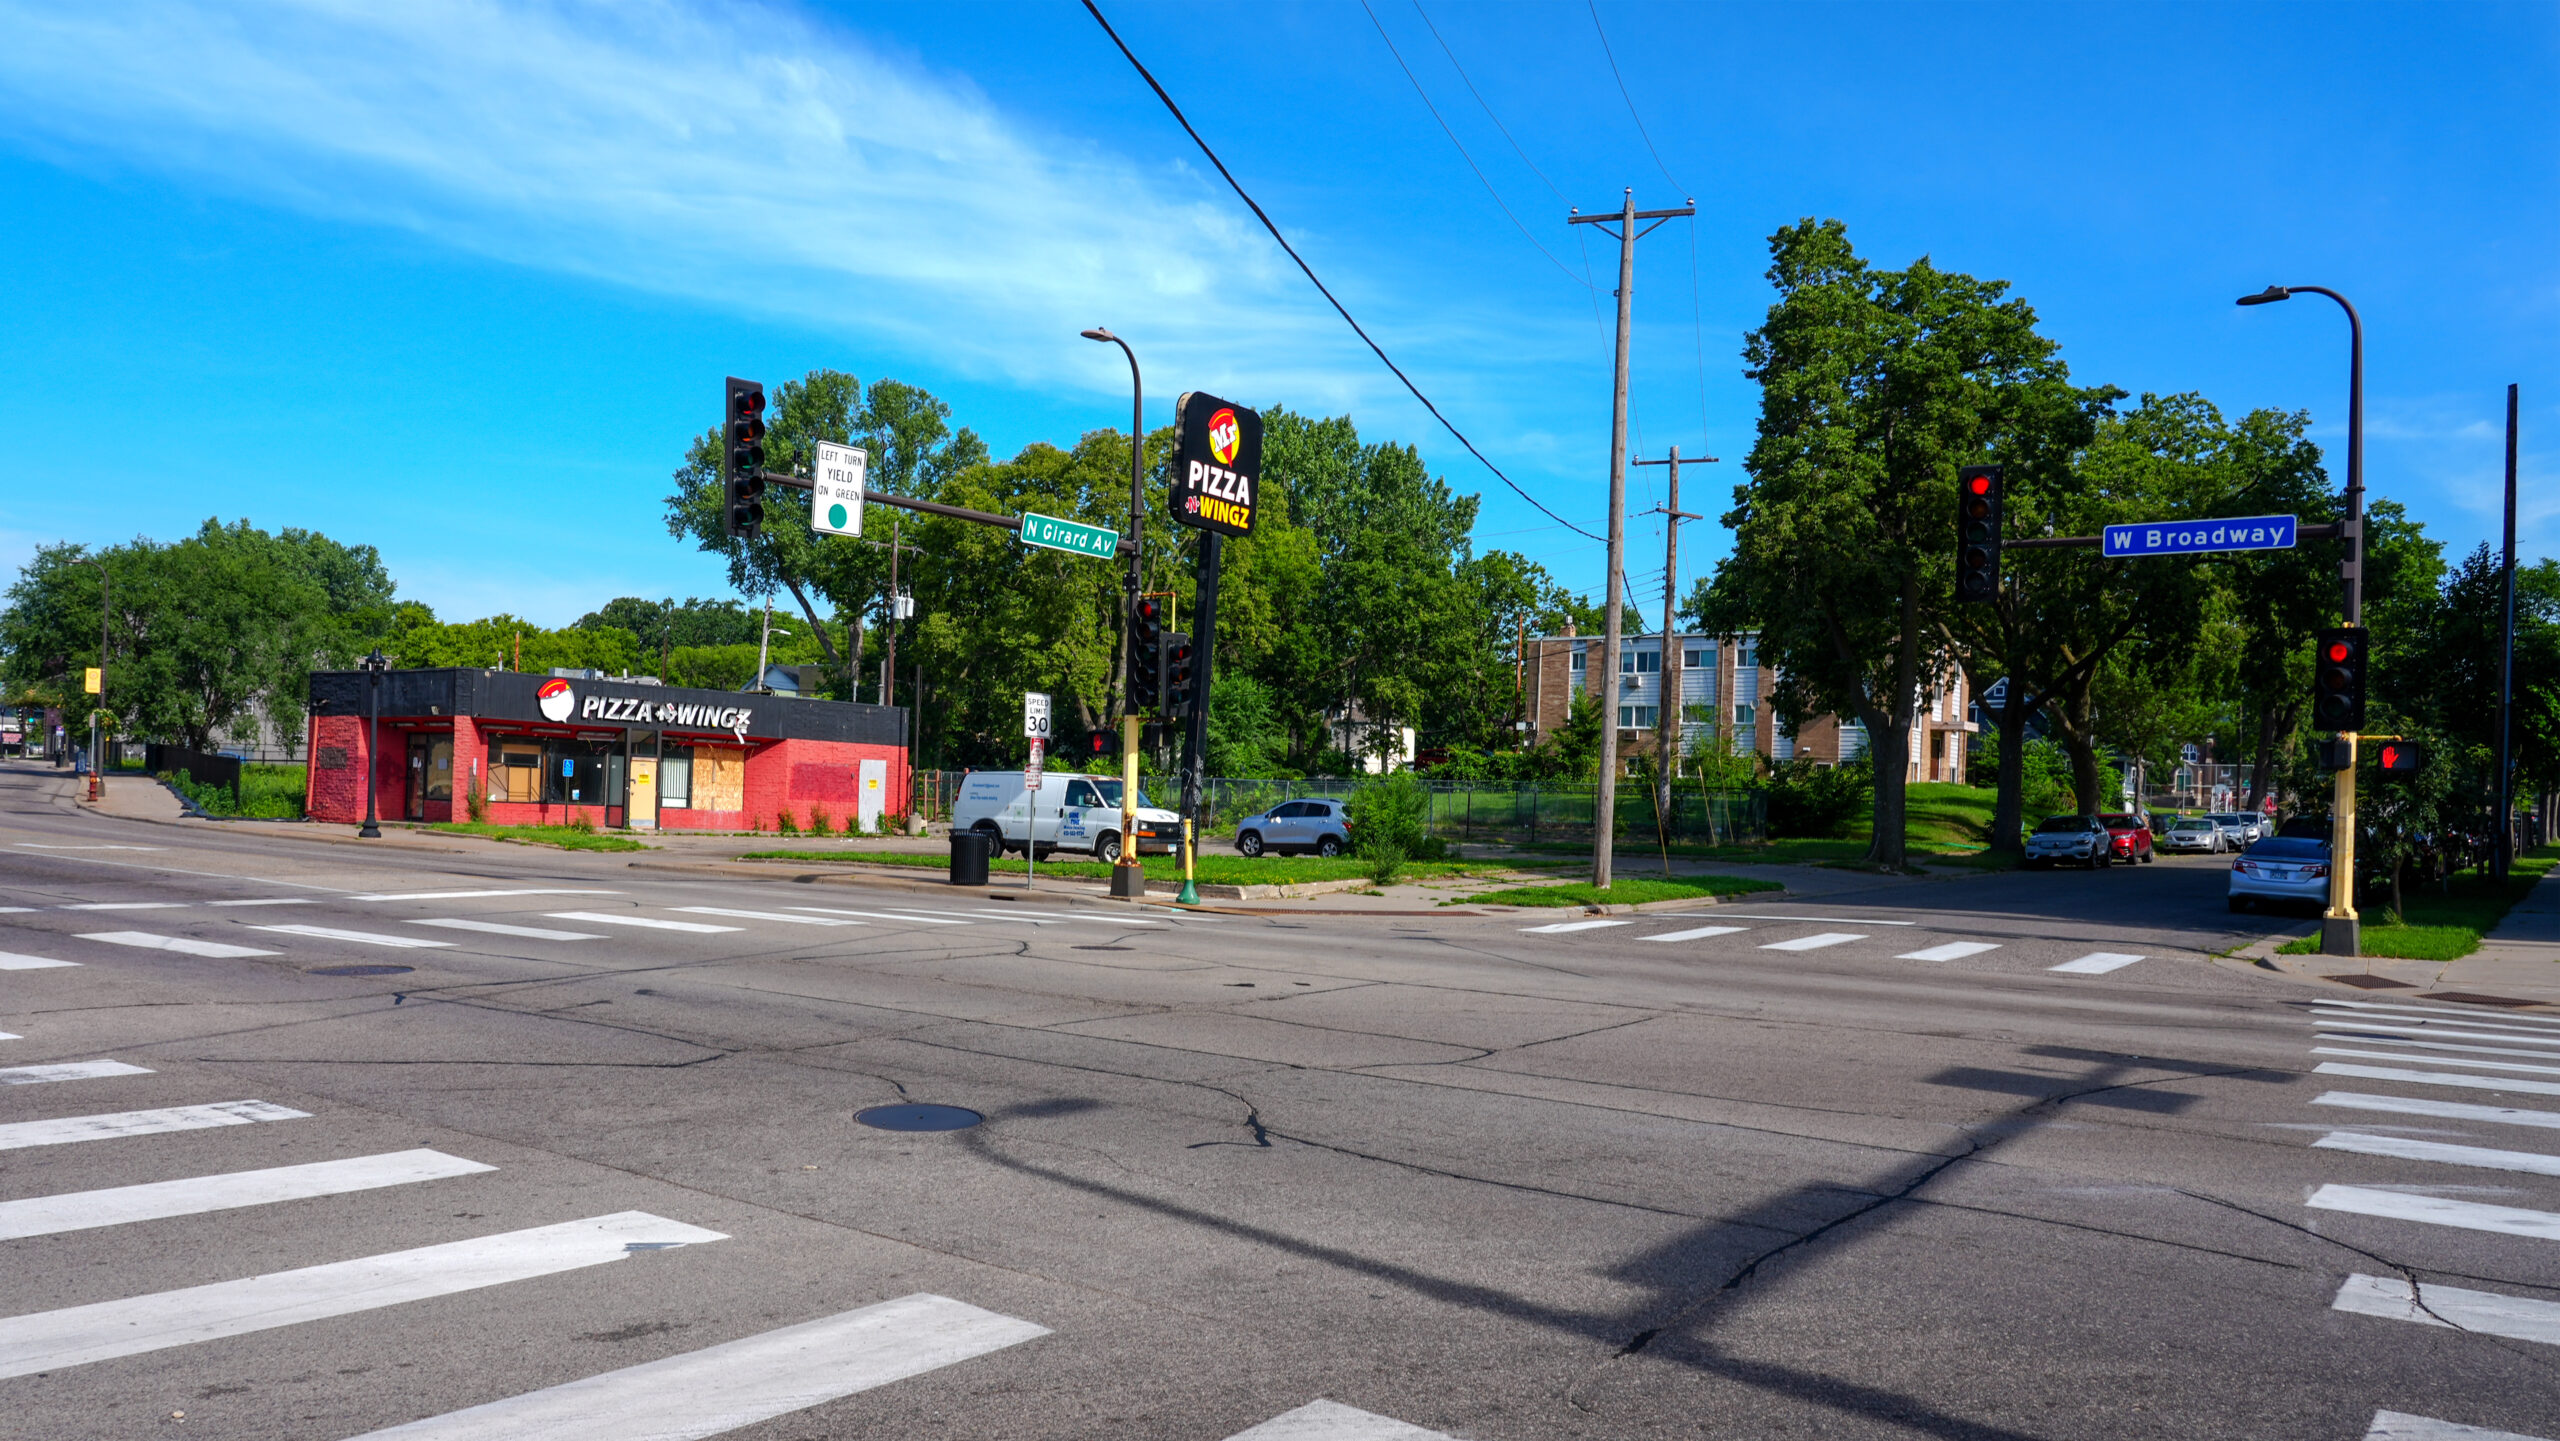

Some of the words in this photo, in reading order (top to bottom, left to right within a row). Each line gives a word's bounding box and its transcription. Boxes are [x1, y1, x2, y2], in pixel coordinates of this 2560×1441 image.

[1211, 422, 1237, 453] Mr
[821, 450, 838, 462] LEFT
[844, 454, 862, 467] TURN
[827, 468, 853, 483] YIELD
[1188, 460, 1250, 505] PIZZA
[818, 485, 829, 496] ON
[836, 488, 860, 501] GREEN
[1200, 495, 1250, 529] WINGZ
[1026, 520, 1038, 537] N
[1043, 523, 1088, 547] Girard
[1092, 535, 1112, 552] Av
[2113, 531, 2132, 549] W
[2146, 526, 2285, 547] Broadway
[582, 696, 653, 723] PIZZA
[1028, 698, 1049, 707] SPEED
[1030, 707, 1047, 715] LIMIT
[1028, 716, 1048, 732] 30
